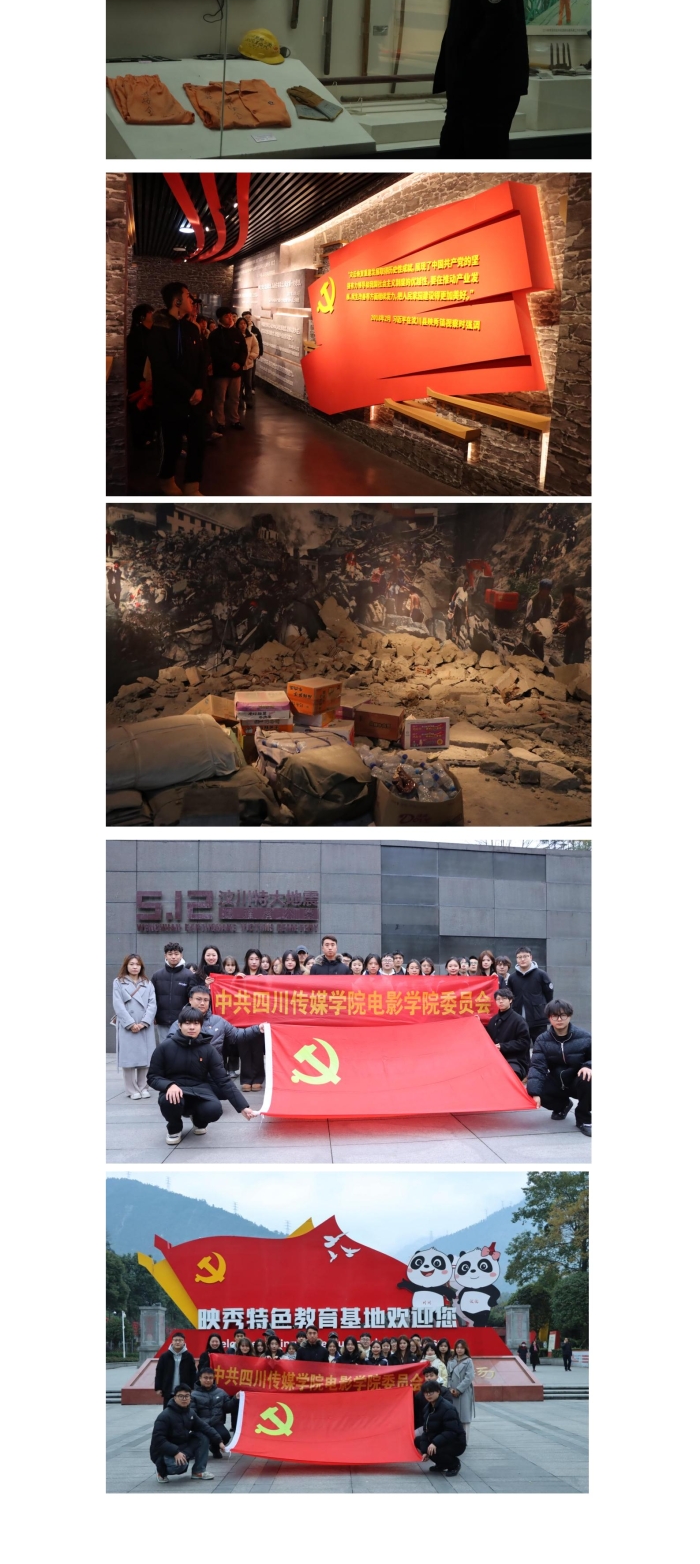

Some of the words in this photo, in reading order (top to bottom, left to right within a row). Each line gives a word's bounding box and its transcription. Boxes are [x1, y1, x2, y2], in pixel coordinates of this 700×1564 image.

[219, 890, 319, 907] 汶川特大地震
[214, 990, 492, 1015] 中共四川传媒学院电影学院委员会
[197, 1307, 458, 1329] 映秀特色教育基地欢迎您
[213, 1364, 425, 1392] 中共四川传媒学院电影学院委员会
